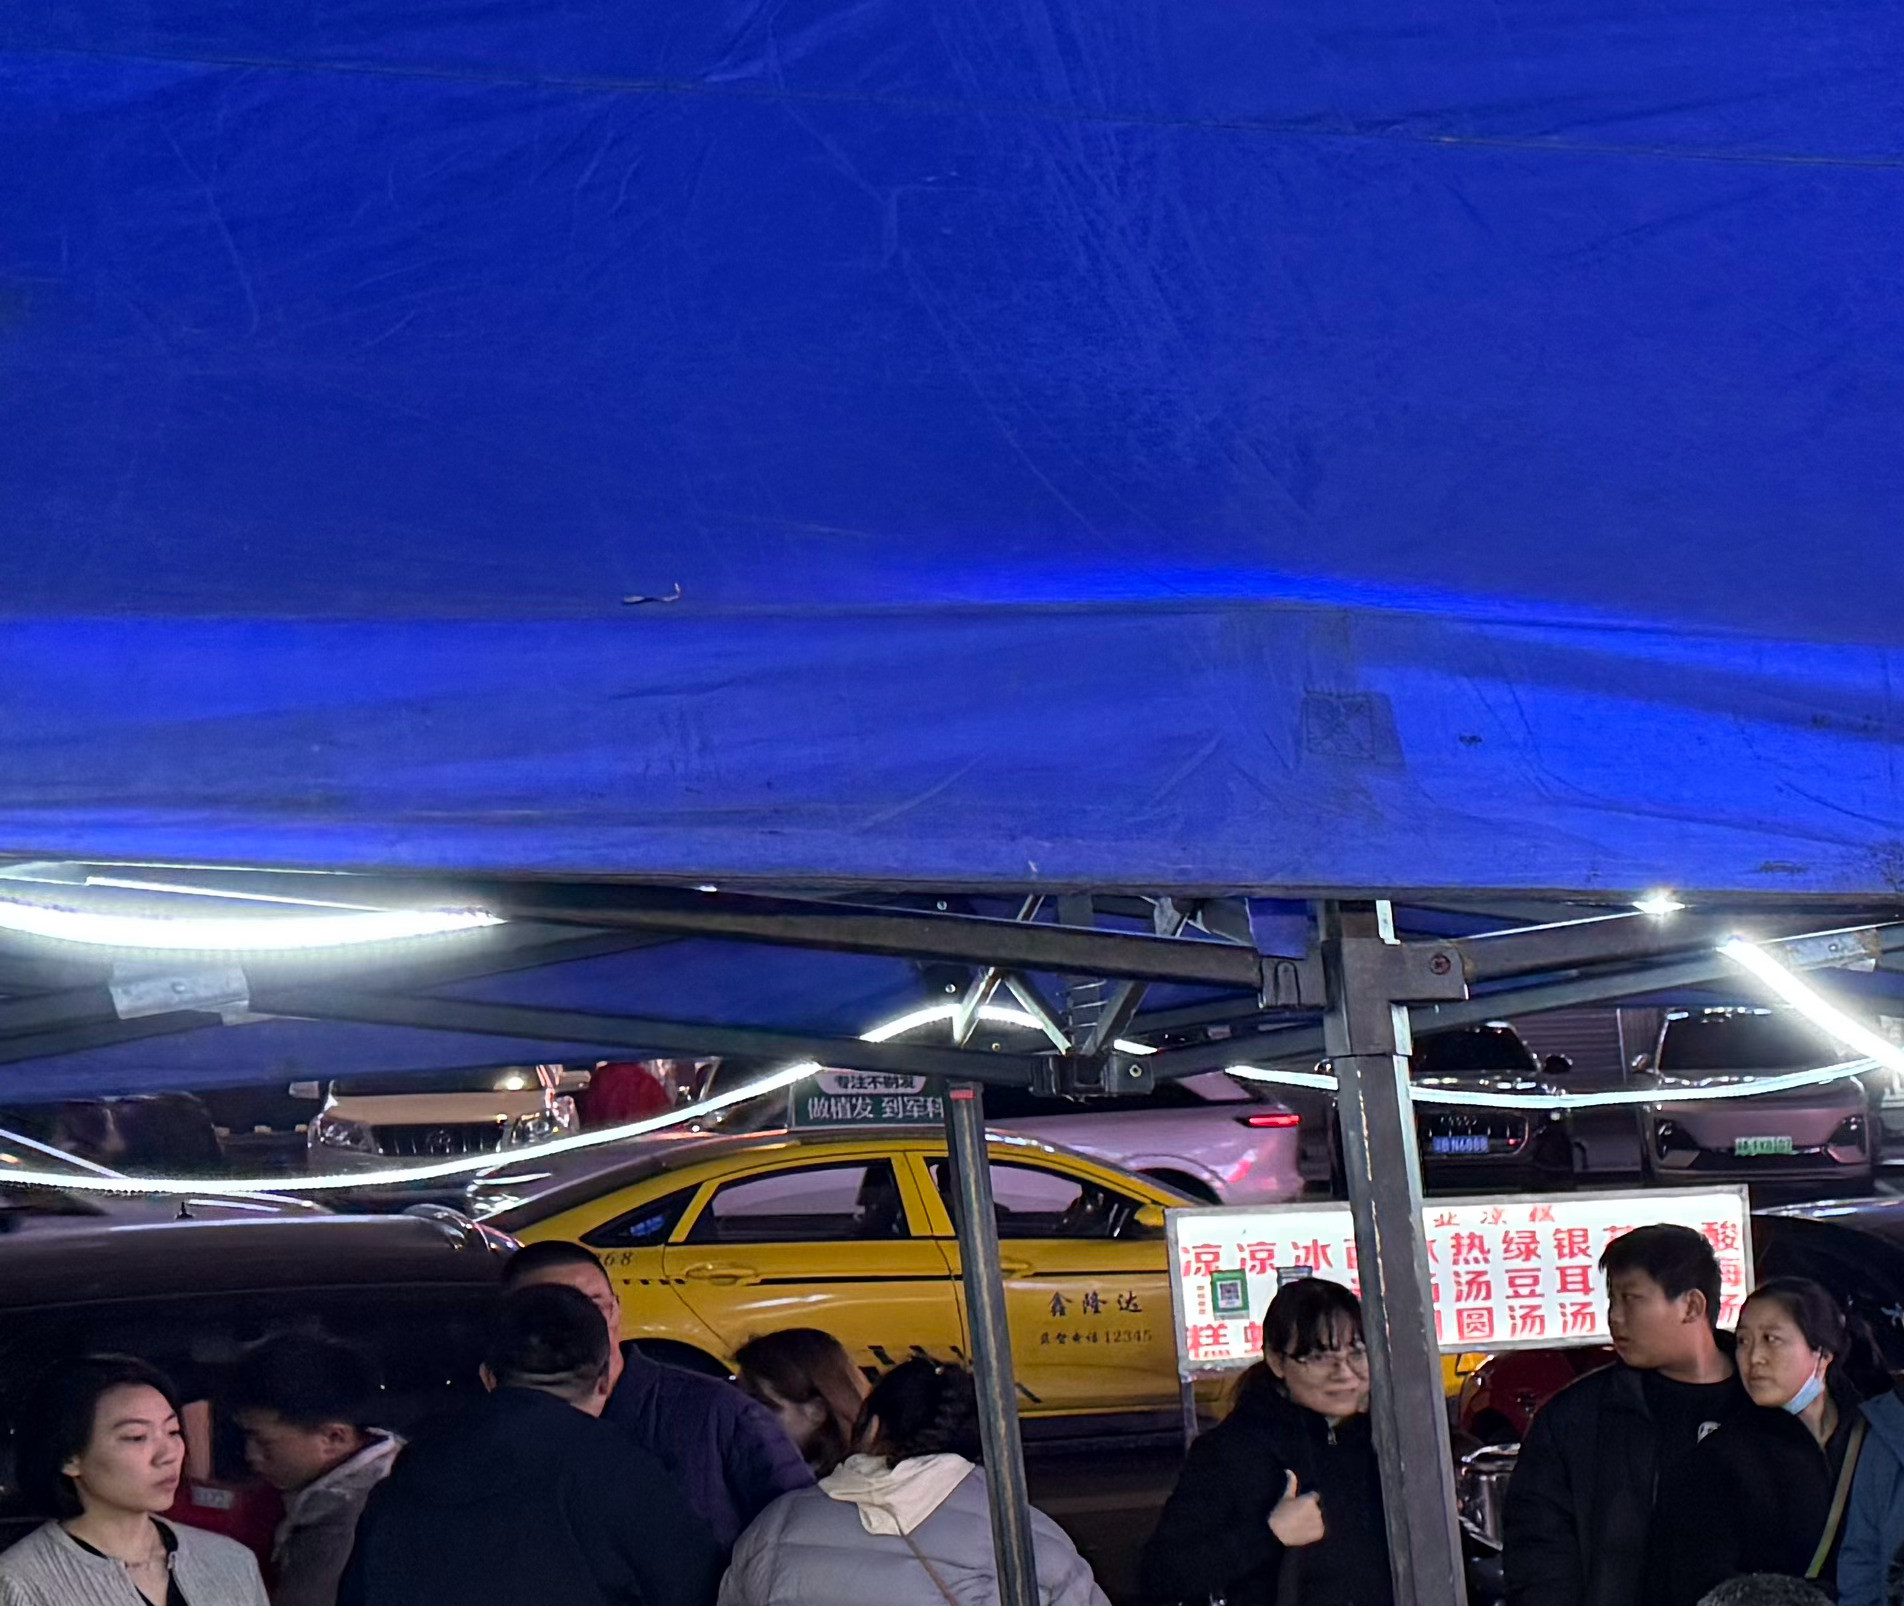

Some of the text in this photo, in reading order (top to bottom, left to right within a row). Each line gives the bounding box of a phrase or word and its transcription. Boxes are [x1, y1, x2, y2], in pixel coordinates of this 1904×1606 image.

[1451, 1232, 1494, 1340] 热汤圆
[1502, 1230, 1545, 1337] 绿豆汤
[1553, 1228, 1596, 1334] 银耳汤
